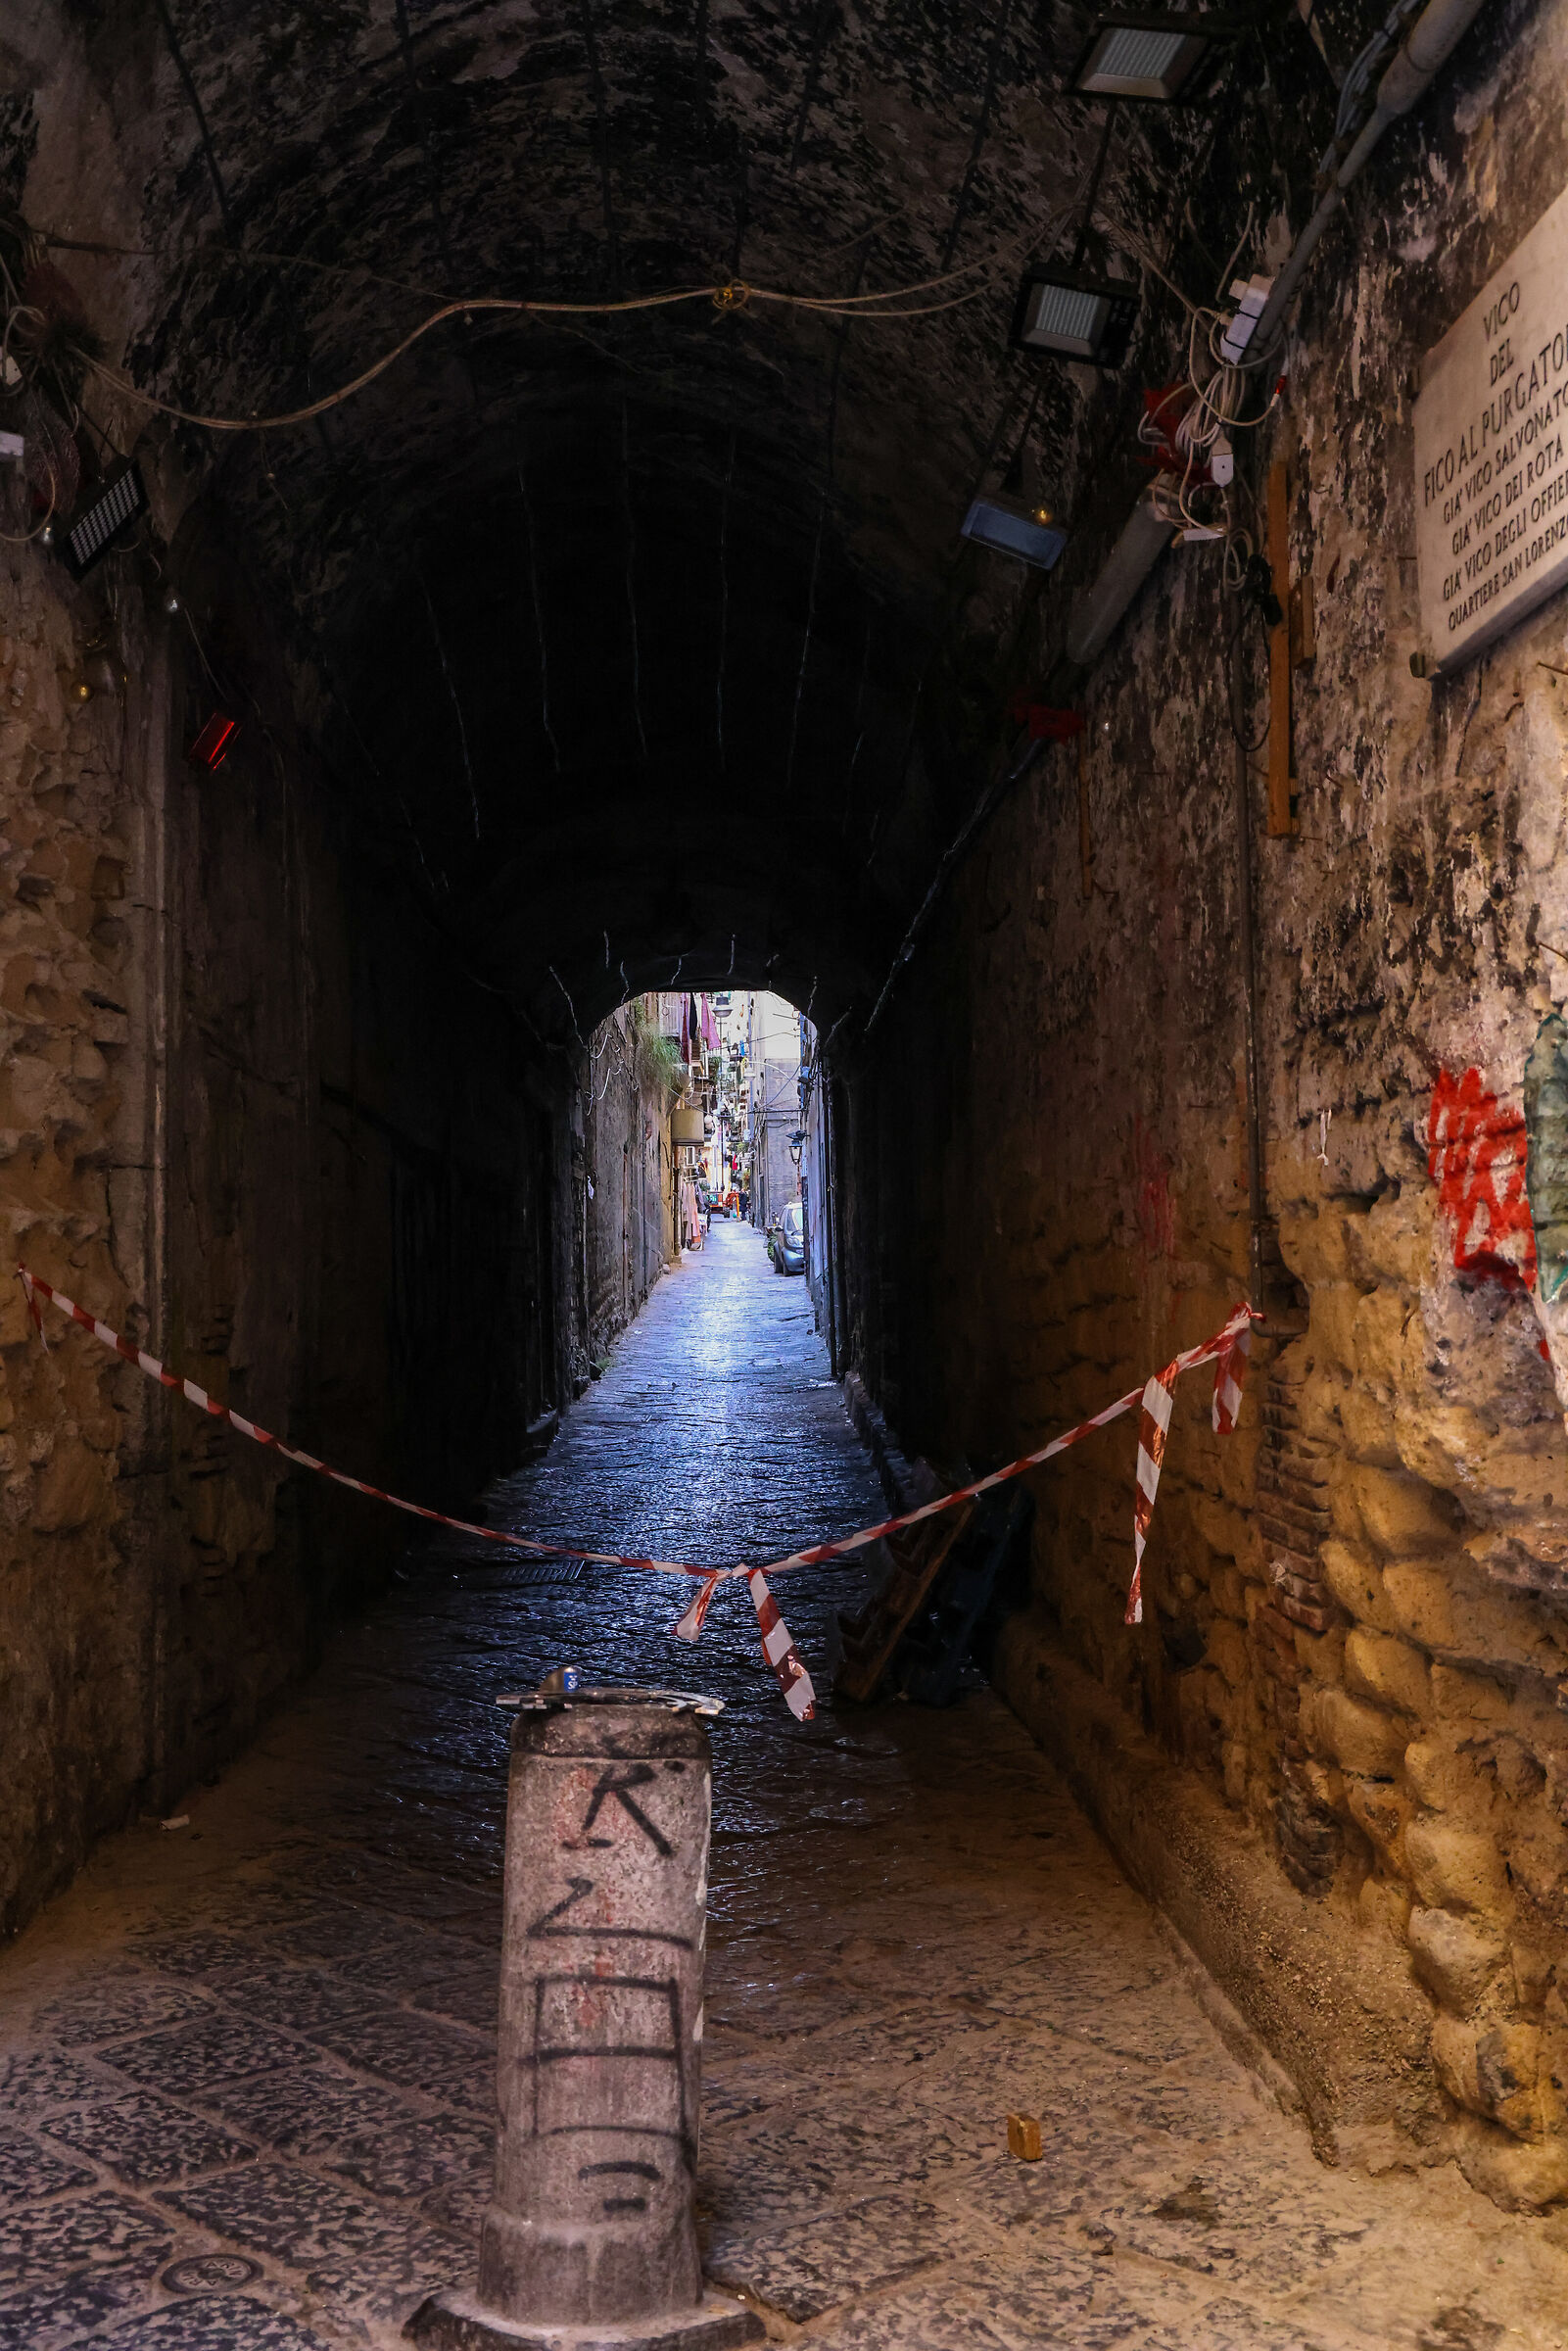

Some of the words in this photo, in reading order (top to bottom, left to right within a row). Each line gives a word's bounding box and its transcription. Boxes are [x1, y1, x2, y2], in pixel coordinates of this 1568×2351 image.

[1483, 281, 1520, 342] VICO
[1490, 338, 1515, 388] DEL
[1424, 448, 1455, 508] FICO
[1457, 424, 1478, 474] AL
[1443, 487, 1463, 525] GIA'
[1465, 460, 1493, 503] VICO
[1451, 517, 1472, 556] GIA'
[1474, 492, 1501, 535] VICO
[1505, 469, 1523, 508] DEI
[1527, 433, 1564, 489] ROTA
[1443, 567, 1462, 601] GIA'
[1464, 542, 1492, 583] VICO
[1495, 507, 1527, 557] DEGLI
[1448, 572, 1500, 632] QUARTIERE
[1502, 552, 1523, 588] SAN
[1525, 513, 1568, 569] LORENZ
